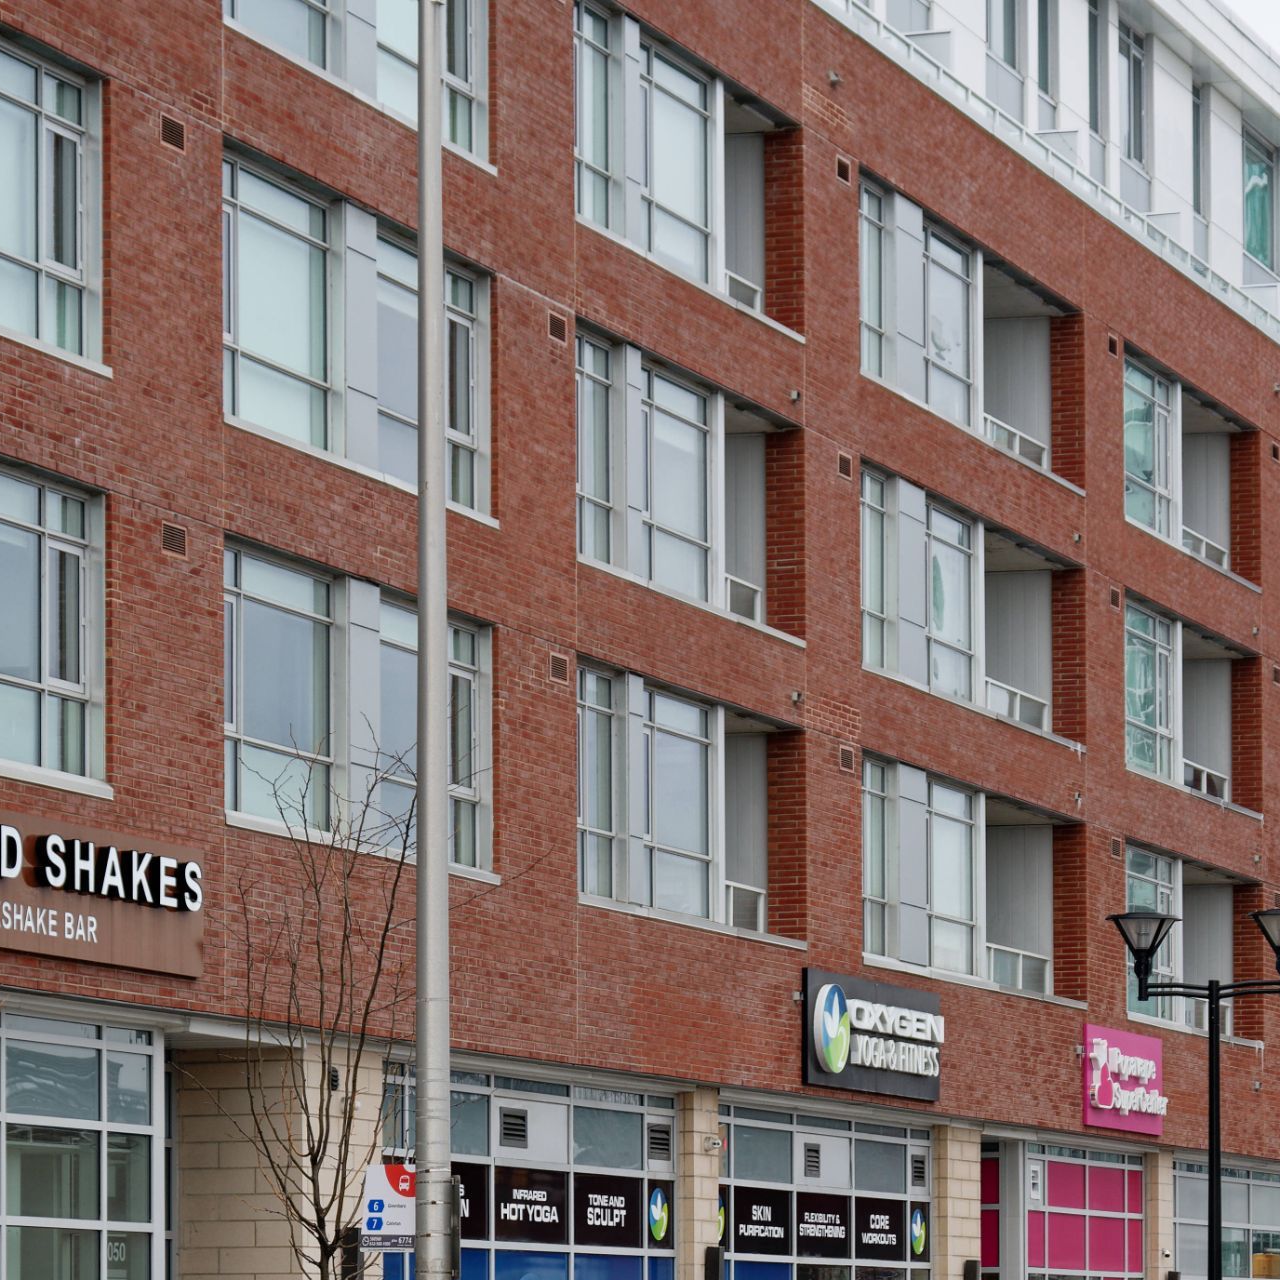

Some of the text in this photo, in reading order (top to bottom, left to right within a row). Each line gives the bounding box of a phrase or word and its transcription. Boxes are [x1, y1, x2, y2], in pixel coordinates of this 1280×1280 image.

[45, 834, 203, 912] SHAKES
[64, 912, 98, 943] BAR
[847, 999, 944, 1043] OXYGEN
[853, 1033, 939, 1077] YOGA & FITNESS
[512, 1189, 547, 1202] INFRARED
[588, 1193, 625, 1208] TONE AND
[373, 1201, 379, 1211] 6
[500, 1203, 559, 1223] HOT YOGA
[752, 1205, 772, 1222] SKIN
[372, 1219, 377, 1229] 7
[587, 1208, 626, 1228] SCULPT
[870, 1214, 890, 1230] CORE
[739, 1224, 784, 1239] PURIFICATION
[862, 1232, 897, 1246] WORKOUTS
[107, 1242, 126, 1261] 050
